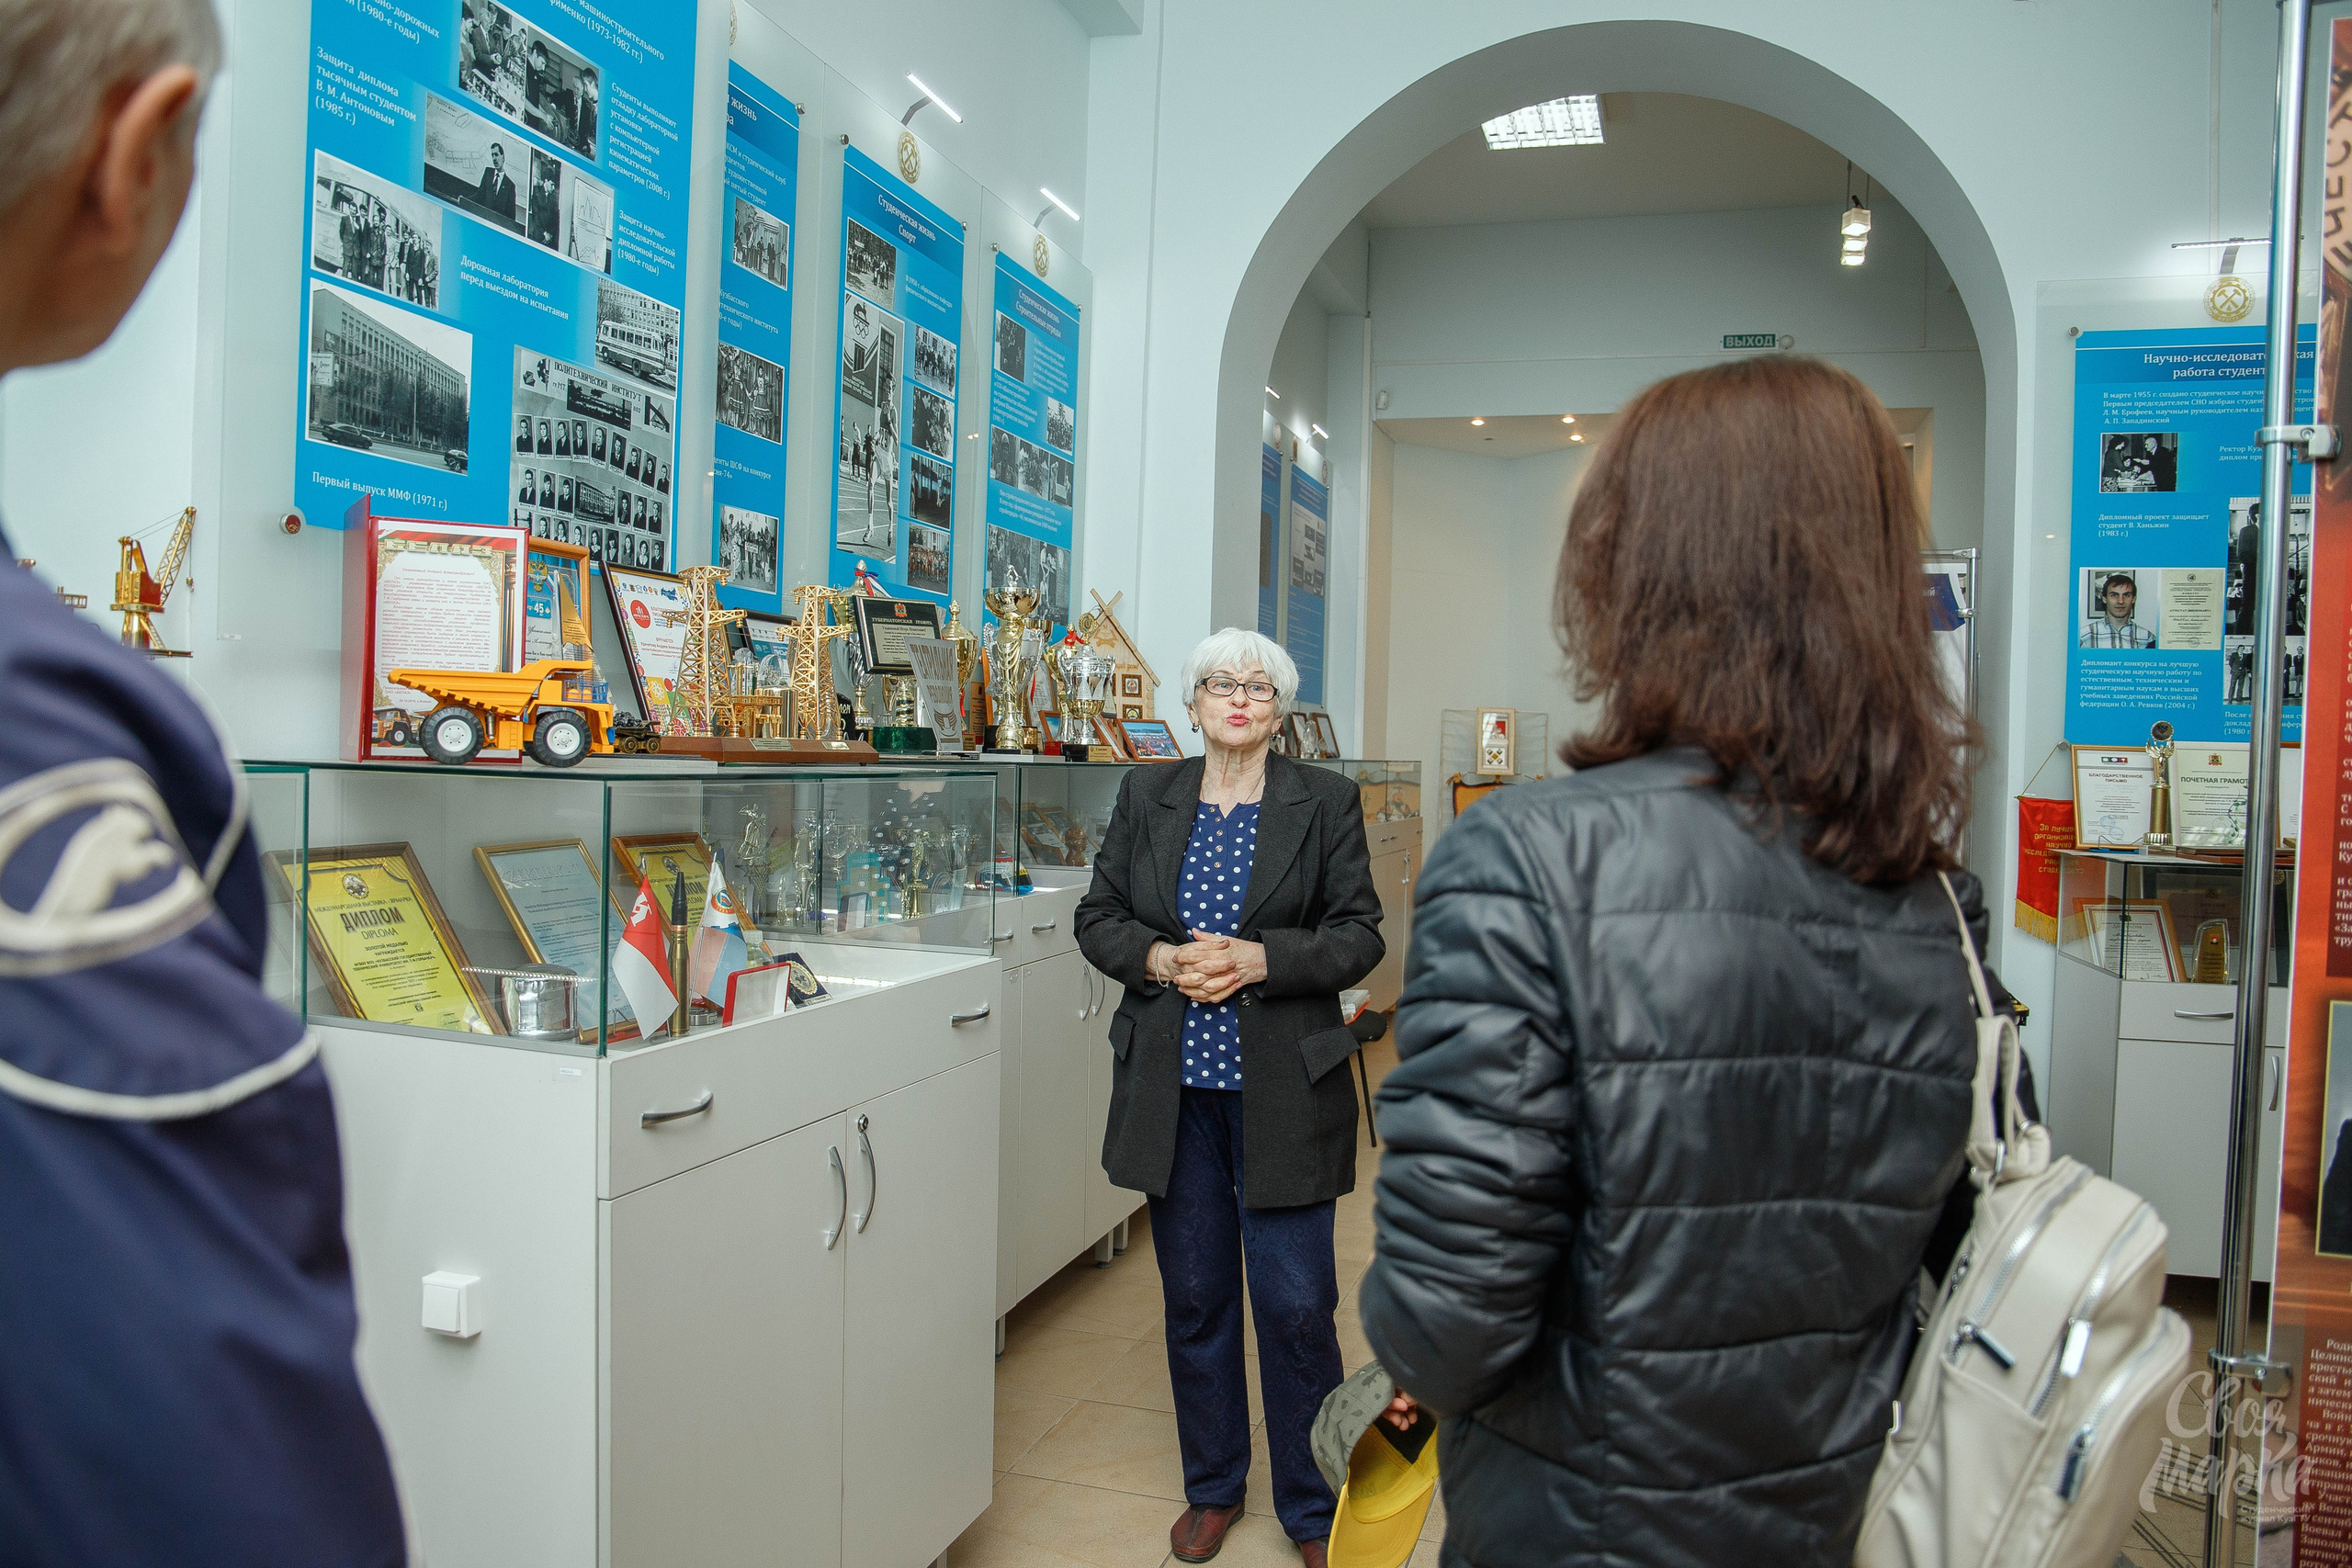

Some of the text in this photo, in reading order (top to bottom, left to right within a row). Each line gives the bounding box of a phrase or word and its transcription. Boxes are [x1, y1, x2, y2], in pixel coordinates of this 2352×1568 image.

[394, 21, 420, 44] годы)
[587, 17, 643, 64] (1973-1982 гг.)
[317, 46, 399, 96] Защита диплома
[316, 65, 416, 121] тысячным студентом
[316, 79, 395, 126] В. М. Антоновым
[612, 82, 677, 129] Студенты выполняют
[315, 96, 356, 125] (1985 г.)
[611, 96, 679, 142] отладку лабораторной
[611, 109, 643, 133] установки
[731, 96, 757, 121] жизнь
[609, 135, 652, 164] регистрацией
[615, 125, 661, 156] компьютерной
[608, 148, 660, 181] кинематических
[608, 160, 645, 186] параметров
[646, 178, 663, 195] (2008
[619, 209, 667, 240] Защита научно-
[878, 194, 936, 242] Студенческая жизнь
[618, 224, 676, 257] исследовательской
[899, 224, 917, 244] Спорт
[617, 237, 675, 270] дипломной работы
[617, 248, 660, 276] (1980-е годы)
[460, 254, 549, 299] Дорожная лаборатория
[460, 271, 569, 321] перед выездом на испытания
[754, 318, 779, 334] института
[1725, 335, 1773, 347] ВЫХОД
[2144, 350, 2313, 365] Научно-исследоваткая
[554, 362, 641, 402] ПОЛИТЕХНИЧЕСКИЙ ИНСТИТУТ
[2173, 367, 2215, 379] работа
[2103, 400, 2132, 409] Первым
[2133, 400, 2189, 408] председателем
[2209, 397, 2235, 406] избран
[2110, 392, 2132, 400] марте
[2189, 389, 2240, 398] студенческое
[2121, 409, 2154, 417] Ерофеев,
[2155, 409, 2188, 417] научным
[2190, 407, 2249, 415] руководителем
[2121, 416, 2170, 424] Западинский
[312, 471, 447, 511] Первый выпуск ММФ (1971 г.)
[534, 602, 544, 614] 45
[2124, 660, 2157, 669] конкурса
[2079, 700, 2120, 708] федерации
[2165, 702, 2186, 710] (2004
[314, 902, 362, 913] МЕЖДУНАРОДНАЯ
[362, 899, 386, 908] ВЫСТАВКА
[340, 907, 404, 932] ДИПЛОМ
[361, 927, 399, 940] DIPLOMA
[386, 941, 408, 949] МЕДАЛЬЮ
[375, 948, 405, 956] НАГРАЖДАЕТСЯ
[2309, 1374, 2336, 1384] ский
[2317, 1387, 2351, 1397] затем
[2301, 1523, 2342, 1537] Воевал
